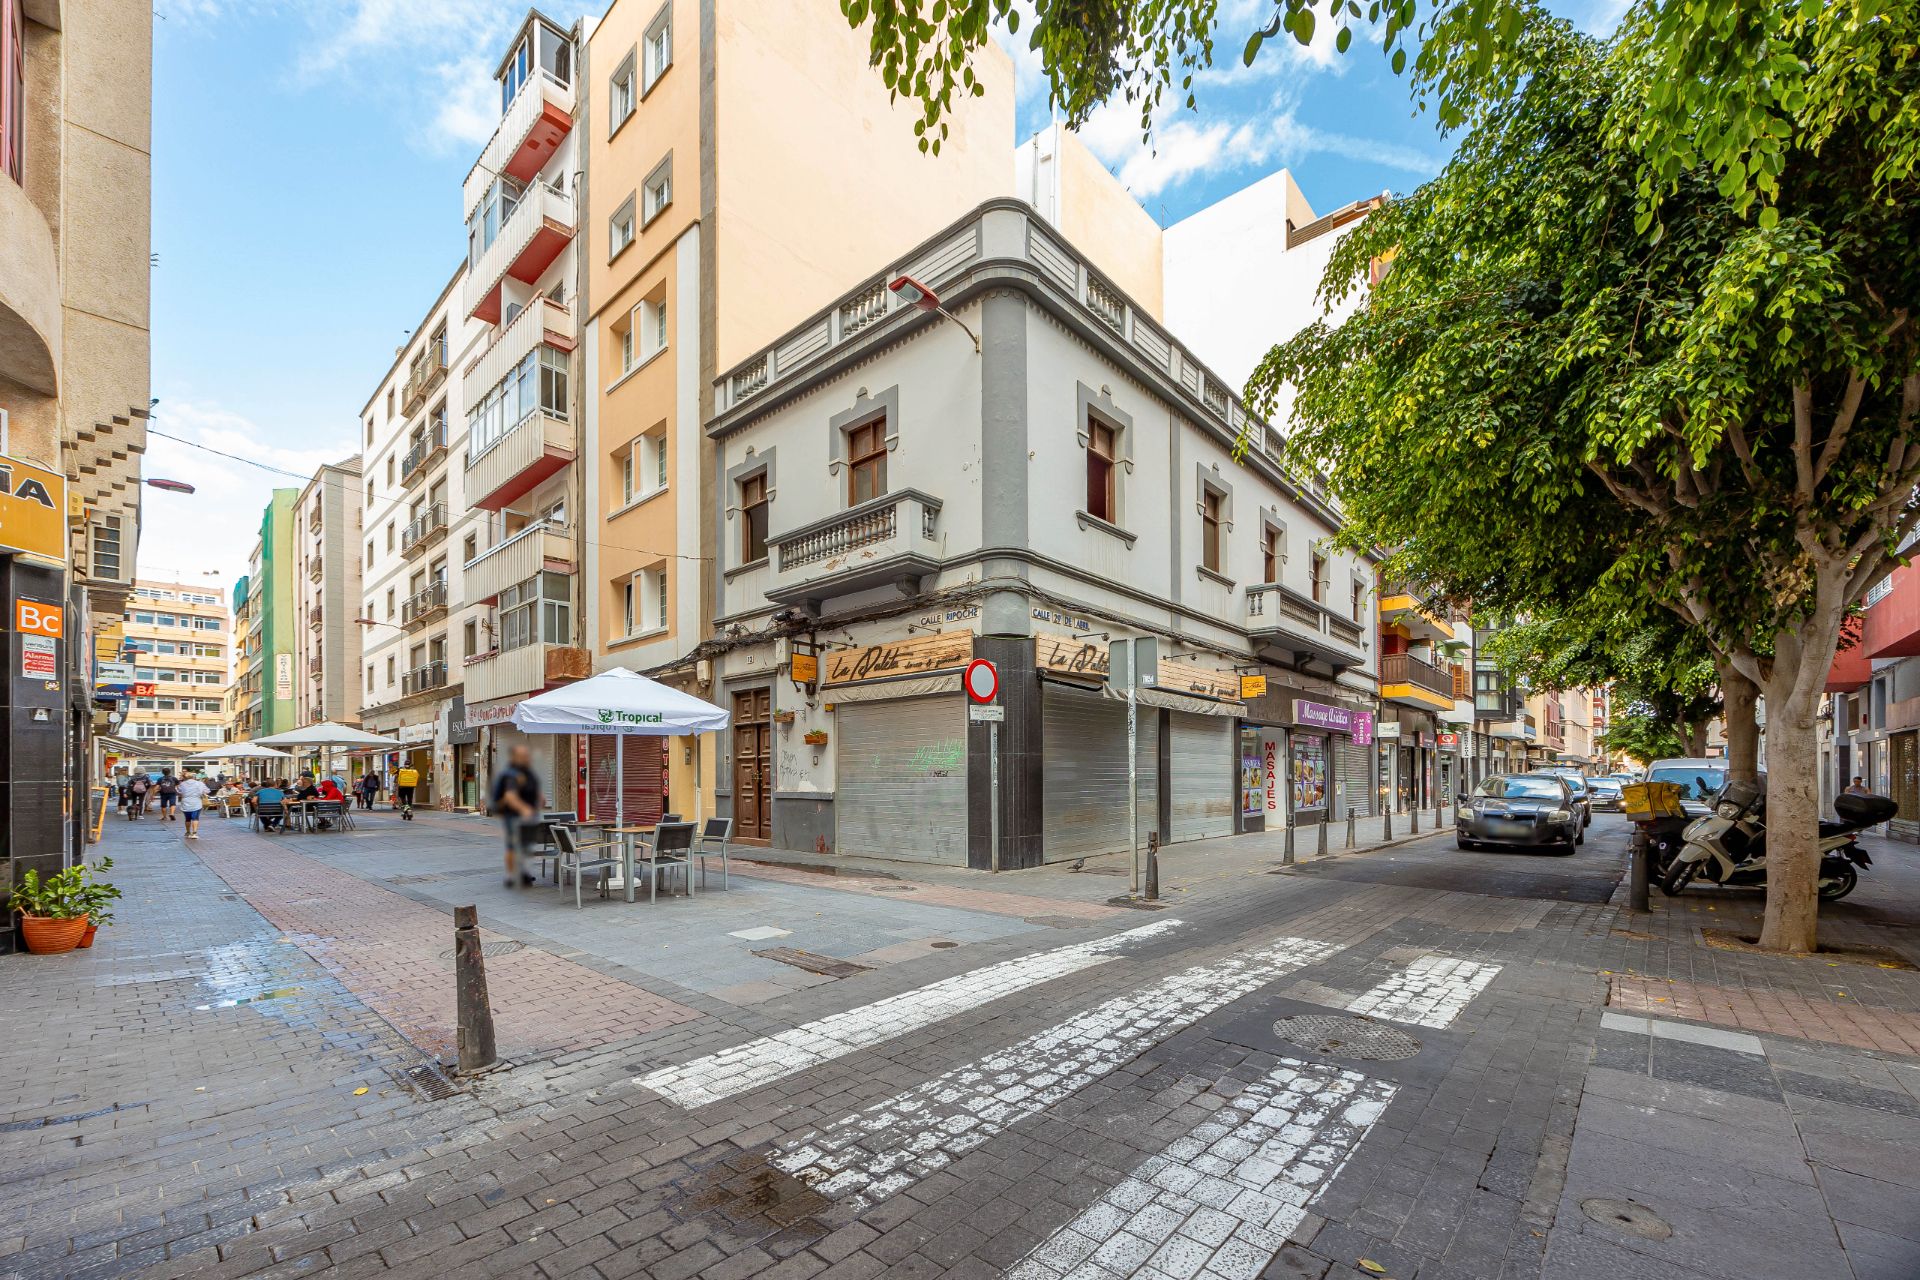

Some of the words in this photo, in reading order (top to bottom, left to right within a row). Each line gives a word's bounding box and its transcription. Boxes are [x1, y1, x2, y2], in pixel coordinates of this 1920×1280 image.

[21, 605, 59, 632] Bc
[920, 615, 941, 625] CALLE
[946, 608, 978, 621] RIPOCHE
[1033, 608, 1050, 618] CALLE
[1065, 617, 1072, 625] DE
[25, 652, 54, 661] Alarma
[616, 710, 663, 724] Tropical
[1302, 703, 1328, 725] Massage
[1264, 741, 1277, 810] MASAJES
